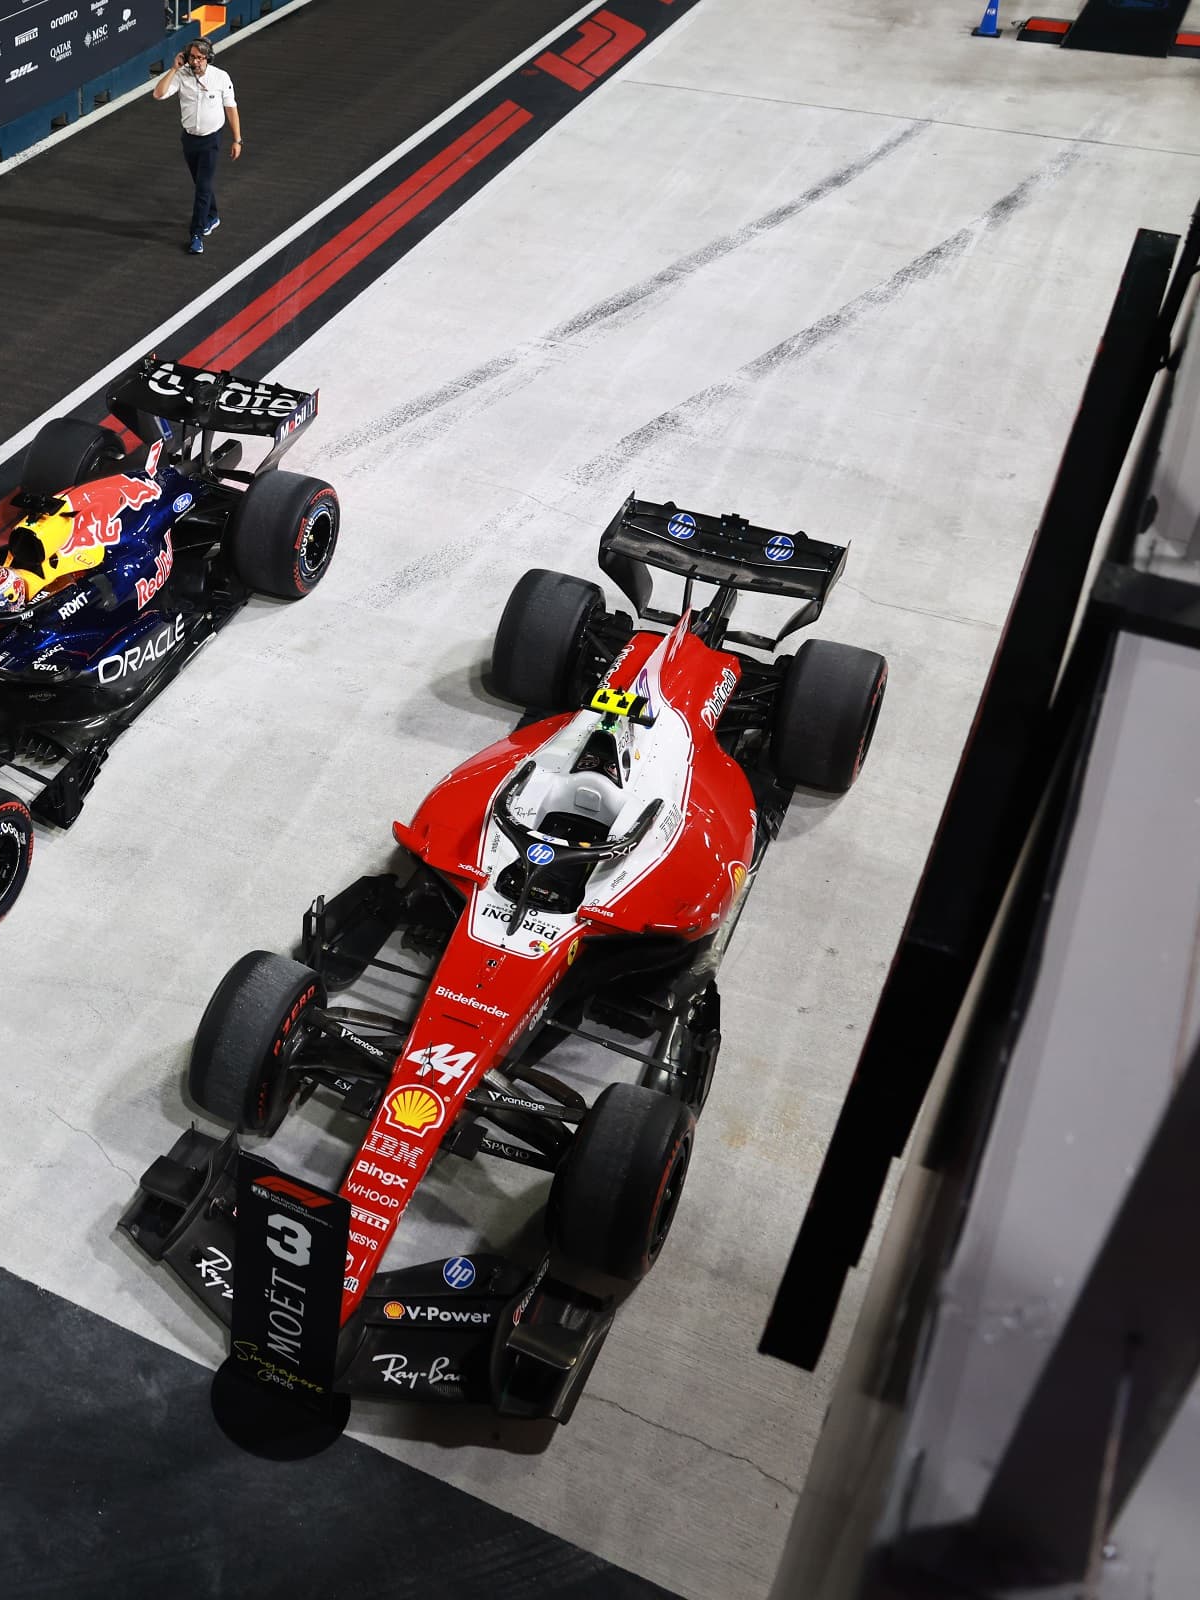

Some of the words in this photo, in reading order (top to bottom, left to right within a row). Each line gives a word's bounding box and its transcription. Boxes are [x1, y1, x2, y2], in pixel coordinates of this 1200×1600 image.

[50, 10, 78, 29] aramco
[92, 24, 109, 40] MSC
[15, 27, 39, 47] PIRELLI
[50, 40, 72, 58] QATAR
[5, 62, 39, 83] DHL
[281, 408, 307, 442] Mobil
[135, 557, 166, 611] Red
[58, 592, 88, 621] ROKT
[98, 612, 186, 684] ORACLE
[709, 668, 737, 719] UniCredit
[529, 844, 554, 864] hp
[282, 984, 316, 1035] ZERO
[435, 985, 510, 1020] Bitdefender
[349, 1034, 384, 1057] vantage
[406, 1042, 477, 1086] 44
[500, 1093, 546, 1112] vantage
[363, 1130, 425, 1170] IBM
[347, 1181, 400, 1209] WHOOP
[350, 1204, 390, 1231] RELLI
[266, 1213, 312, 1267] 3
[349, 1229, 378, 1251] NESYS
[195, 1246, 234, 1299] Ray-
[446, 1258, 473, 1288] hp
[265, 1267, 307, 1367] MOËT
[406, 1305, 492, 1324] V-Power
[233, 1340, 324, 1394] Singapore
